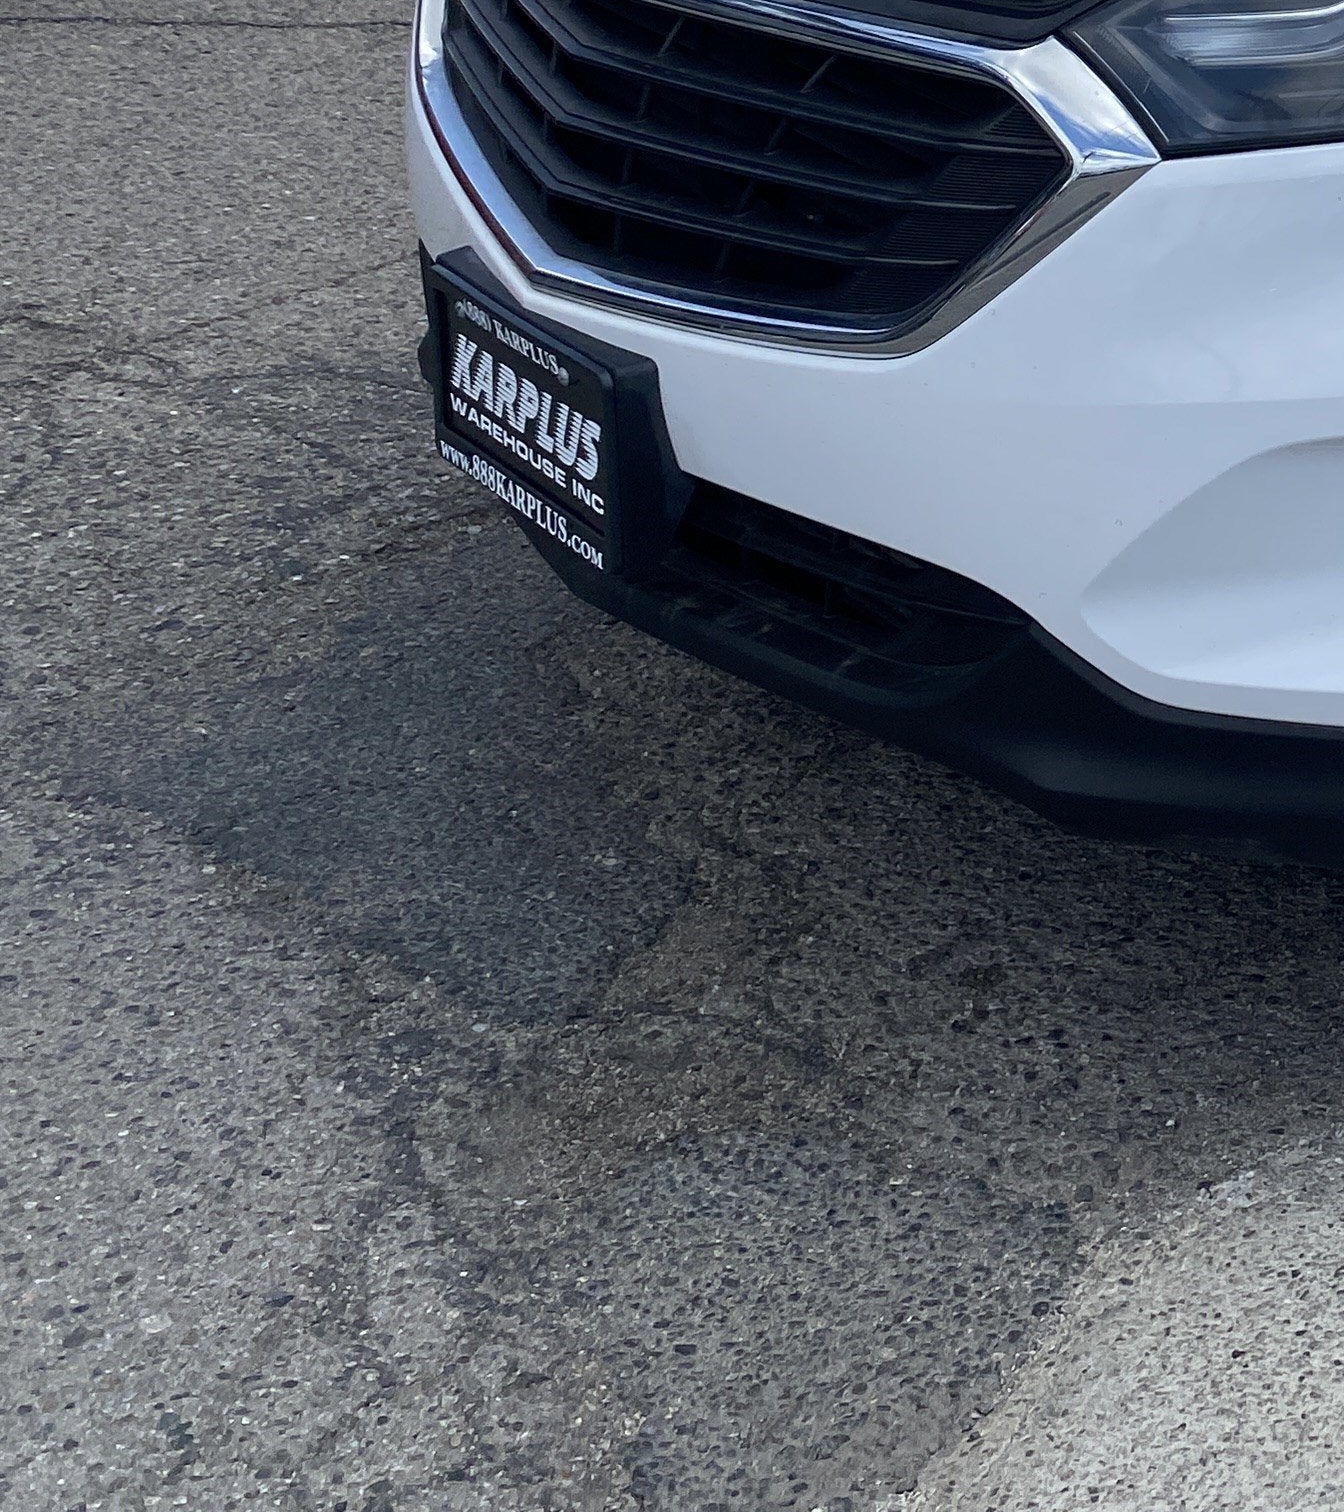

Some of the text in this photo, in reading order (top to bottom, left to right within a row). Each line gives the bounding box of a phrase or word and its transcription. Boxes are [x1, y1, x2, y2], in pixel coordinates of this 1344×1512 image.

[450, 332, 601, 481] KARPLUS
[492, 319, 560, 375] KARPLUS
[450, 392, 605, 516] WAREHOUSE INC
